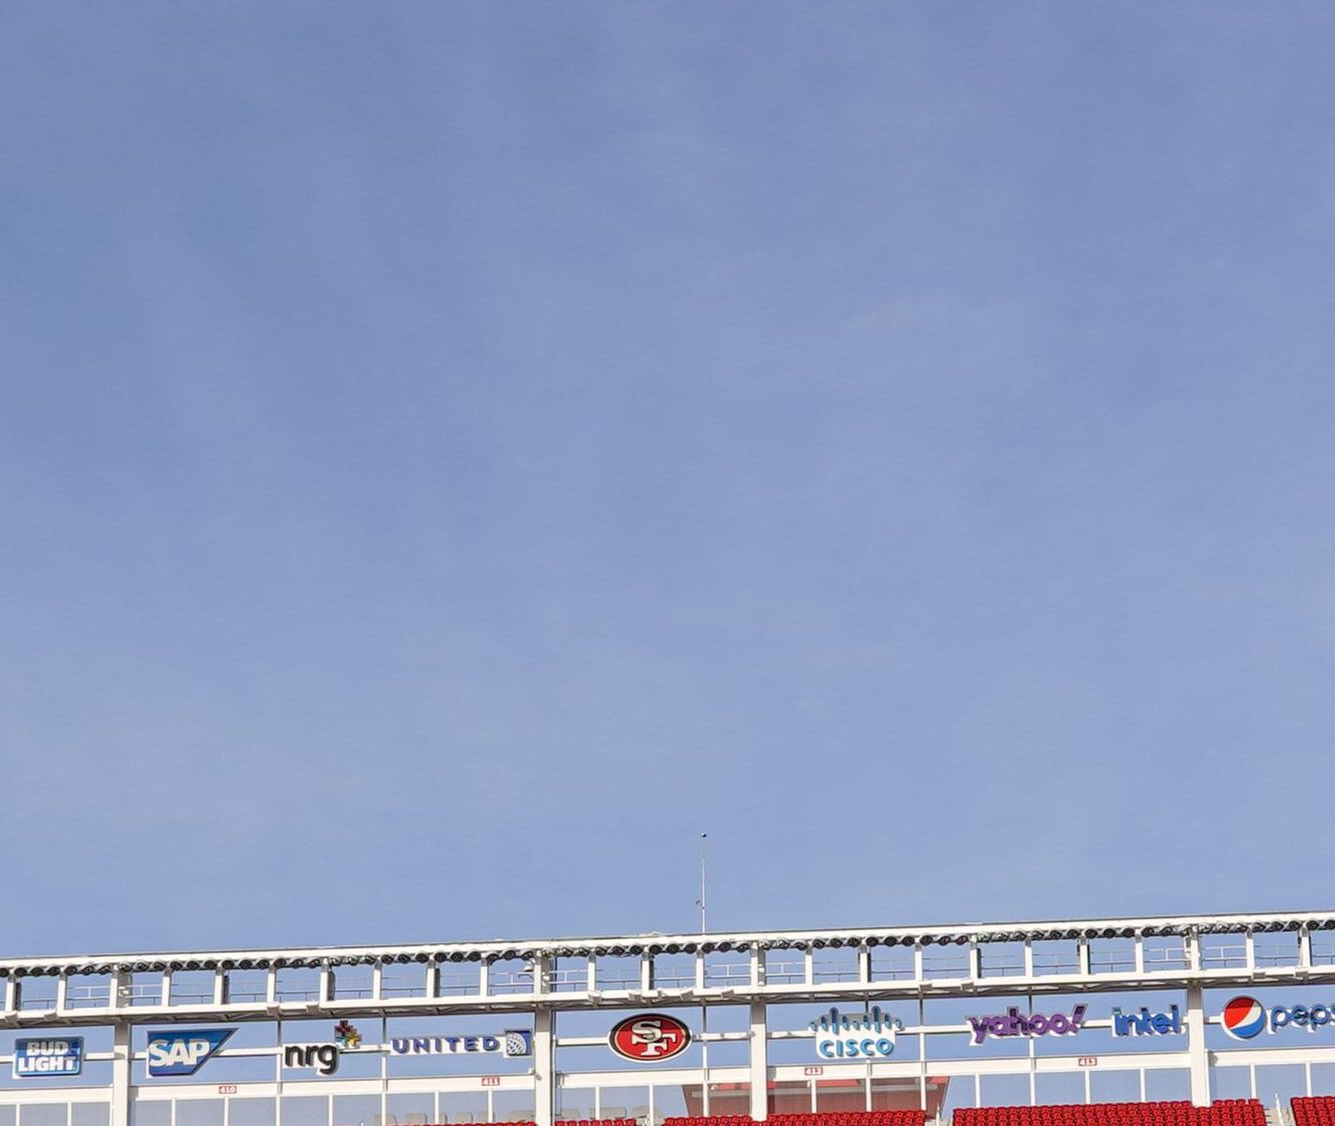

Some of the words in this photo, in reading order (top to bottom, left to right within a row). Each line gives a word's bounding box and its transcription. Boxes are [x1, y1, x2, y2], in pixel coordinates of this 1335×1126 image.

[969, 1004, 1088, 1044] yahoo!
[1111, 1006, 1180, 1036] intel
[26, 1040, 69, 1057] BUD
[149, 1038, 210, 1068] SAP
[283, 1043, 339, 1075] nrg
[390, 1036, 500, 1054] UNITED
[19, 1056, 77, 1073] LIGHT
